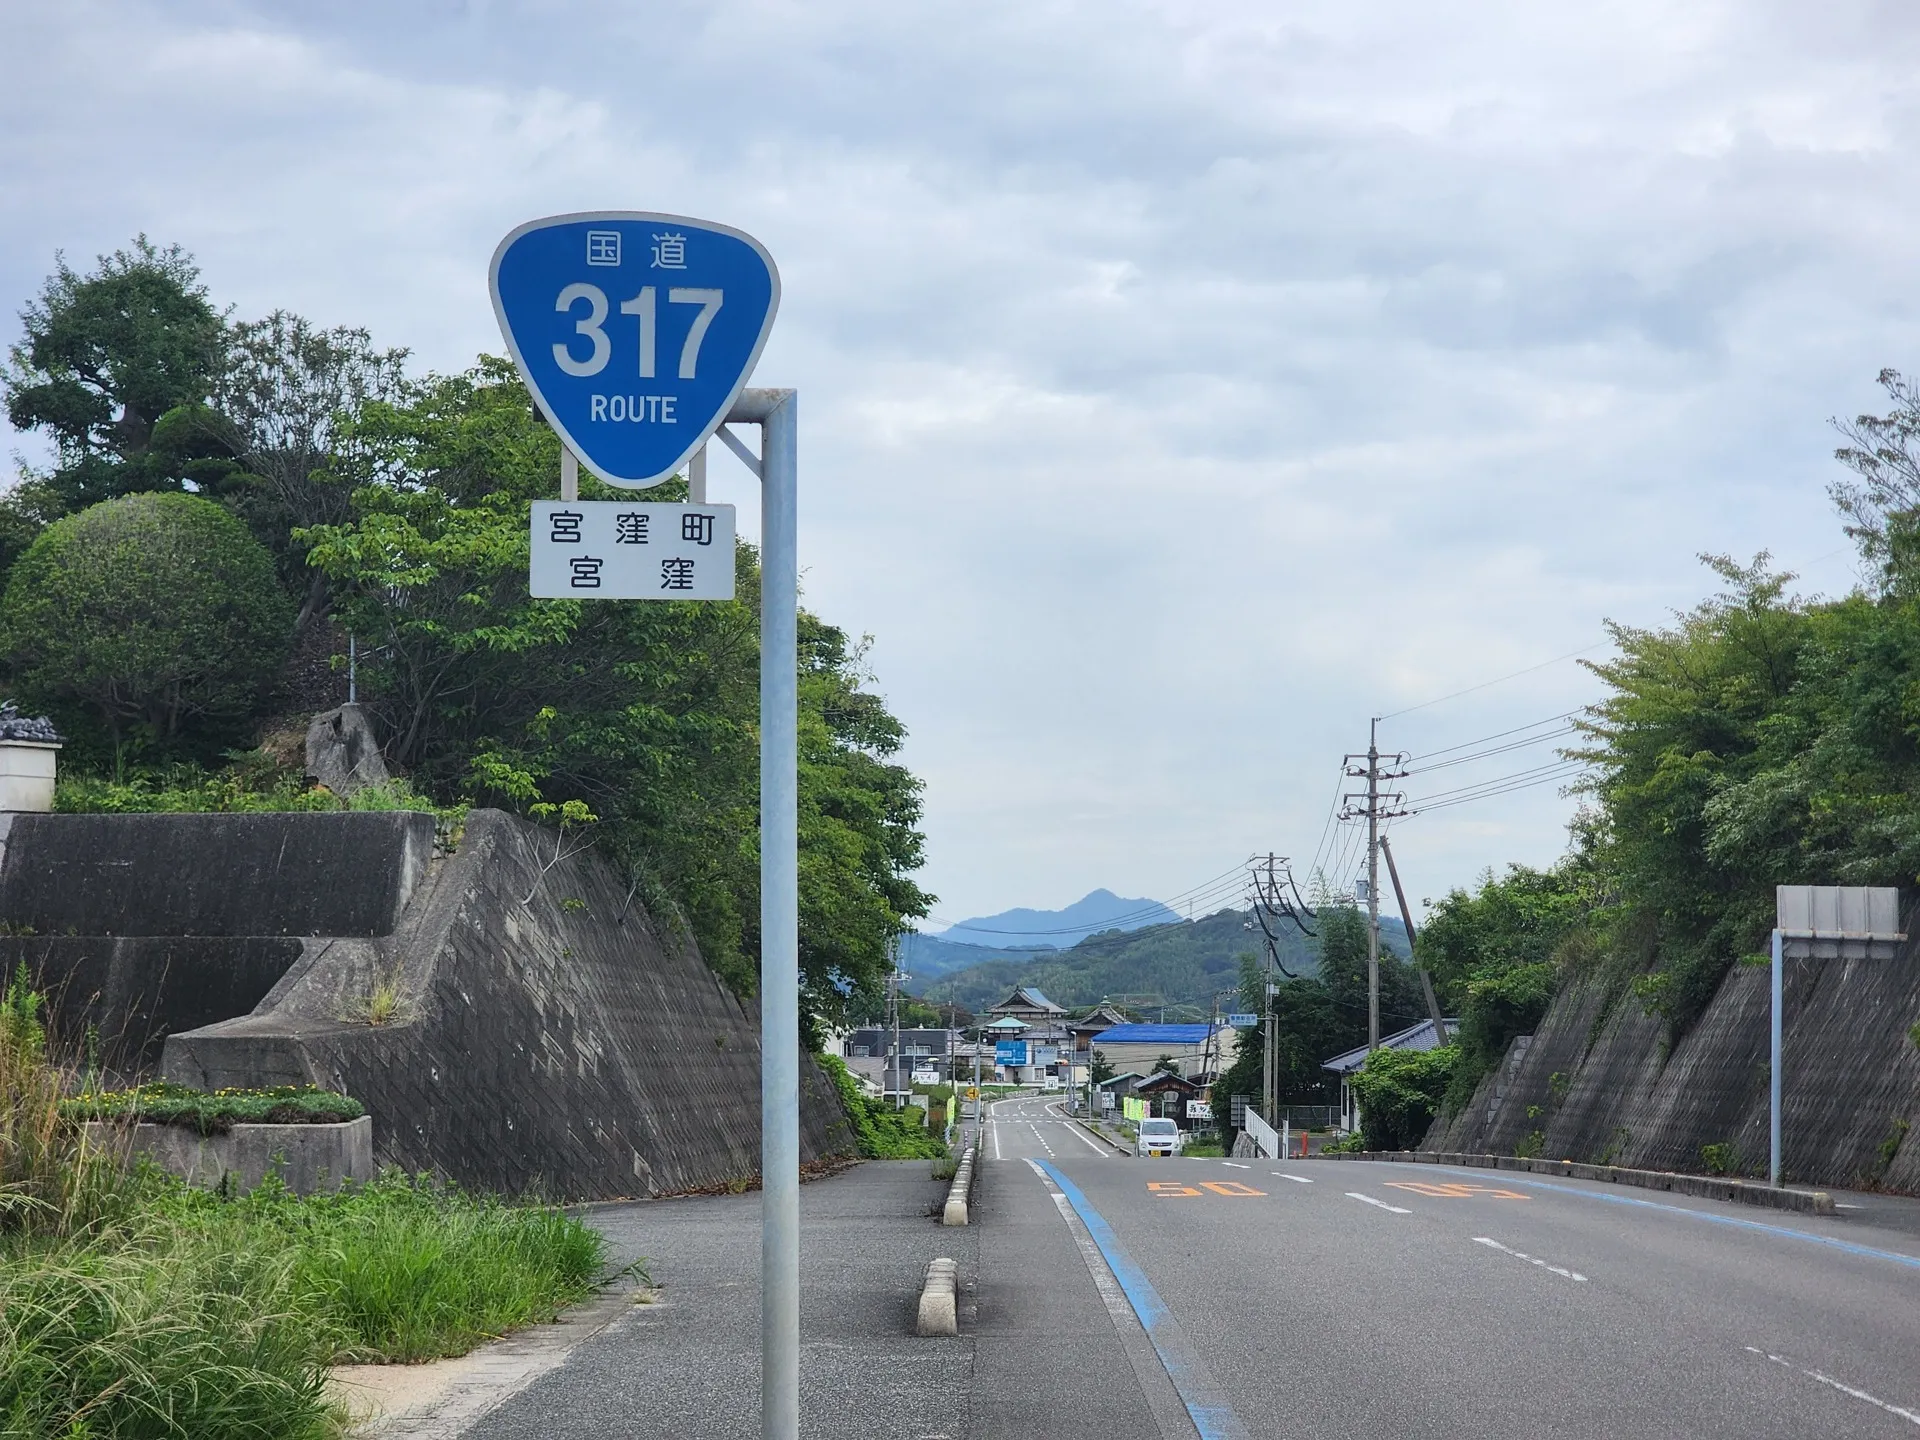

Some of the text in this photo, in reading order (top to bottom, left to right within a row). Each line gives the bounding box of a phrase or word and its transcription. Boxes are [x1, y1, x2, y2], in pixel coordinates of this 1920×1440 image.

[587, 231, 687, 269] 国道
[552, 282, 724, 379] 317
[591, 395, 677, 424] ROUTE
[549, 510, 715, 546] 宮窪町
[570, 555, 695, 590] 宮窪
[1147, 1182, 1268, 1197] 50
